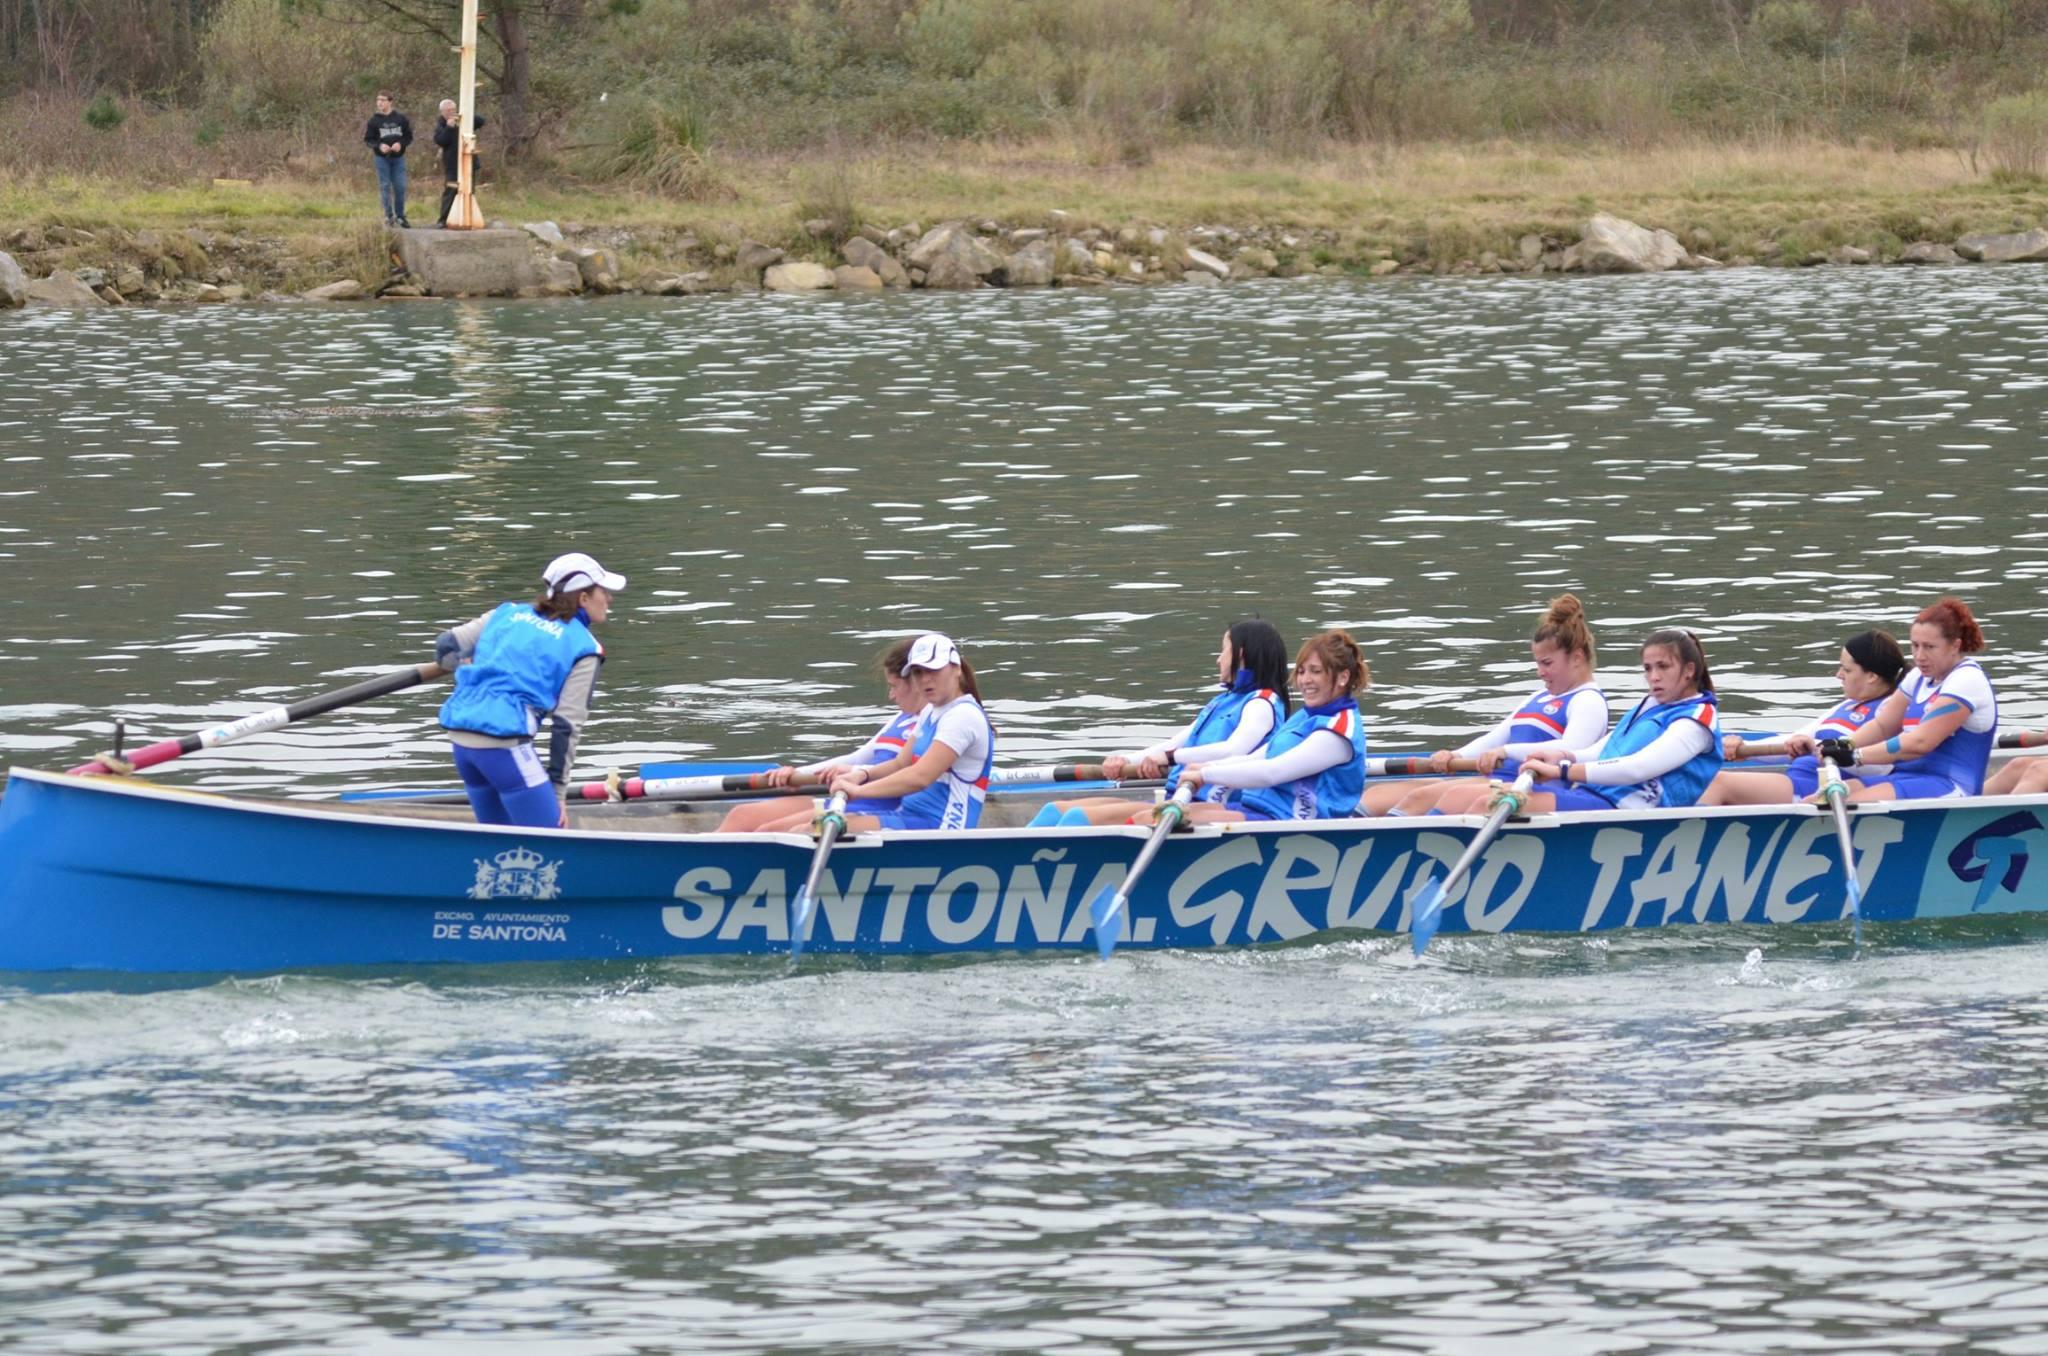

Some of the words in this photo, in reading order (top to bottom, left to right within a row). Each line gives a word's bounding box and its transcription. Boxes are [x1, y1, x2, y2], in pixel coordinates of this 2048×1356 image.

[1168, 832, 1546, 945] GRUPO
[1580, 816, 1904, 932] TANET
[483, 912, 570, 923] AYUNTAMIENTO
[432, 924, 463, 939] DE
[468, 922, 567, 942] SANTOÑA
